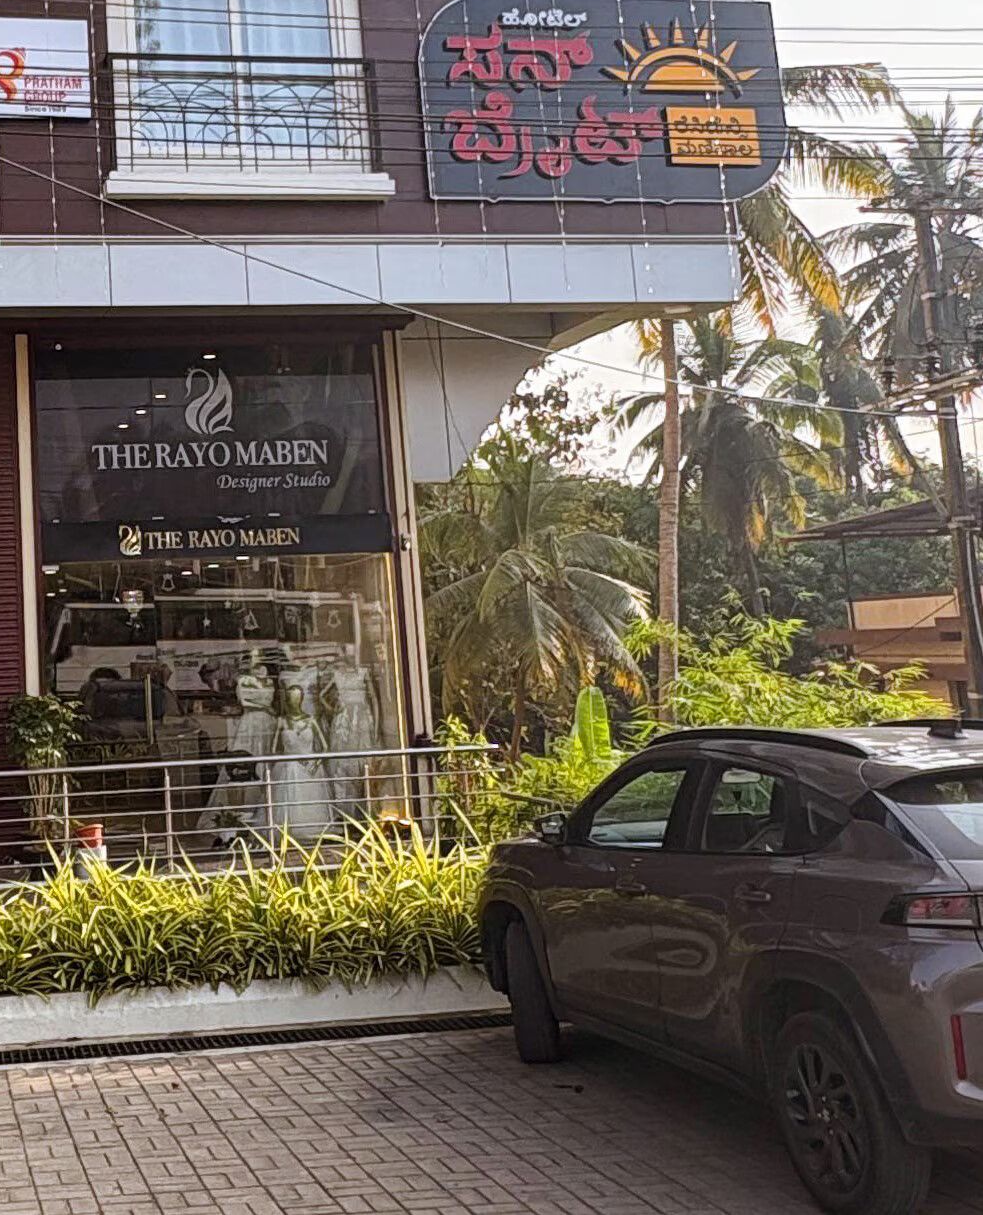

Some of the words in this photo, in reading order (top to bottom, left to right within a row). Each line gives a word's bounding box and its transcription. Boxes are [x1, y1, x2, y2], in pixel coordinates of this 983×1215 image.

[502, 7, 587, 26] ಹೋಟೆಲ್
[446, 22, 594, 88] ಸನ್
[24, 76, 83, 89] PRATHAM
[92, 443, 151, 470] THE
[154, 441, 231, 468] RAYO
[235, 440, 329, 466] MABEN
[217, 473, 282, 493] Designer
[283, 471, 331, 489] Studio
[145, 531, 183, 550] THE
[189, 529, 235, 548] RAYO
[240, 527, 300, 547] MABEN
